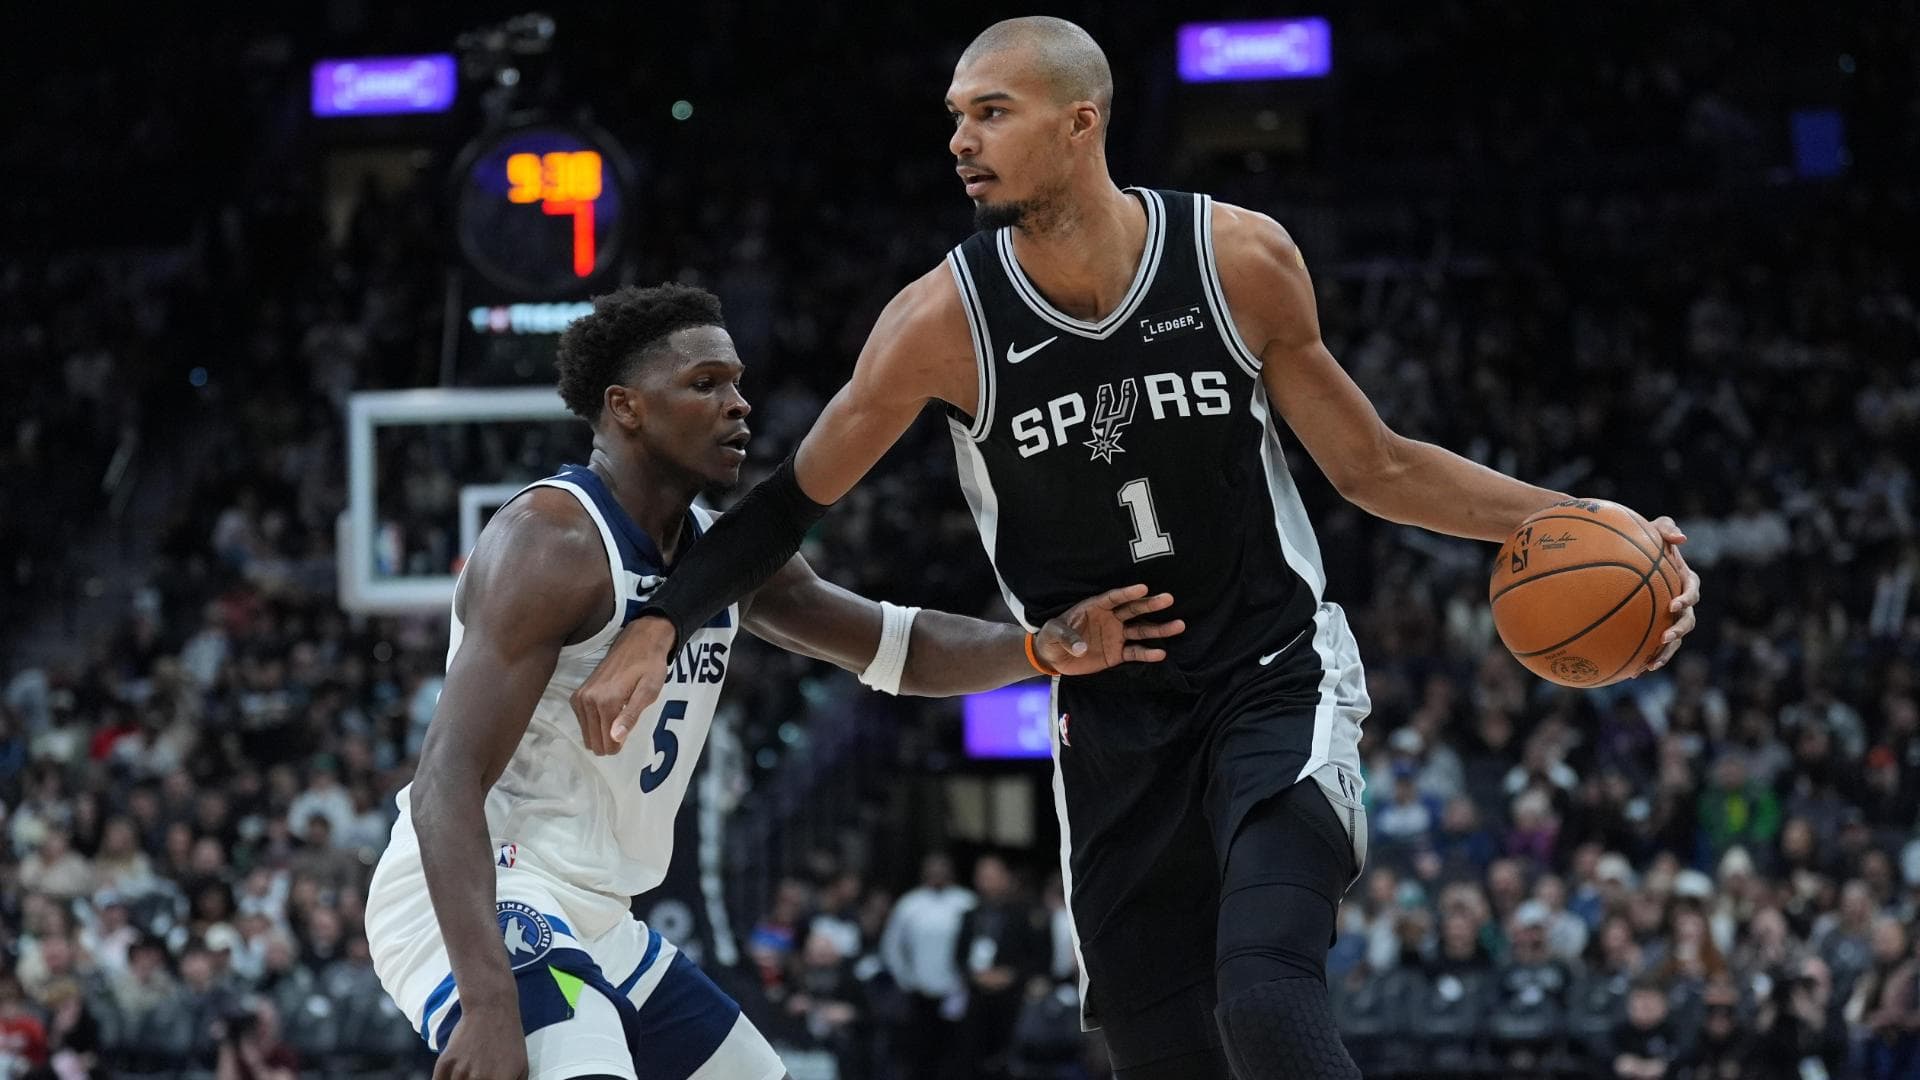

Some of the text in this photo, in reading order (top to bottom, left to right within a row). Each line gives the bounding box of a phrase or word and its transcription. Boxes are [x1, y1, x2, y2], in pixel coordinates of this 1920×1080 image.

[1149, 315, 1195, 334] LEDGER
[1011, 371, 1231, 462] SPURS
[1117, 477, 1175, 563] 1
[665, 643, 728, 684] LVES
[640, 700, 689, 794] 5
